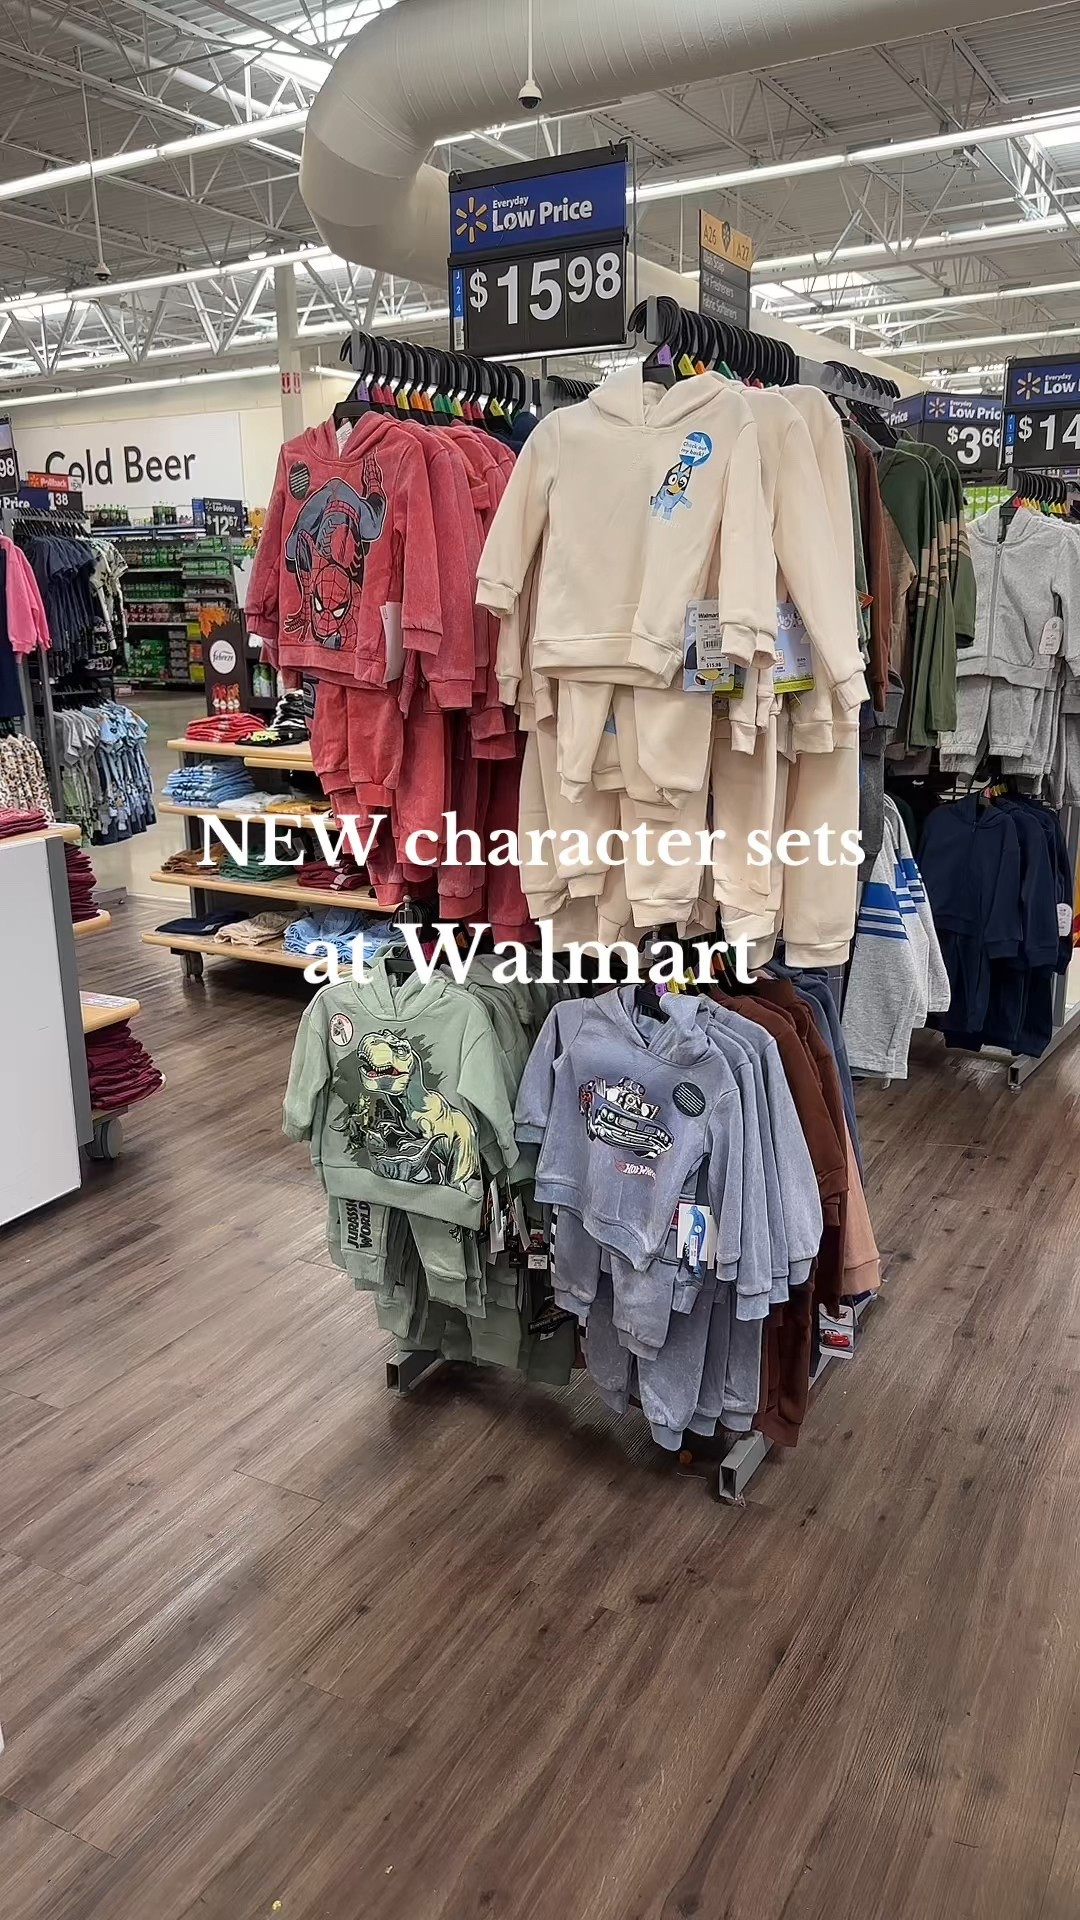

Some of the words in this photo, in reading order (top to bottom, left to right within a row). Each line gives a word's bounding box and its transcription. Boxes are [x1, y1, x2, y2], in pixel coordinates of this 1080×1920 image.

[492, 196, 529, 209] Everyday
[492, 209, 535, 232] Low
[540, 197, 593, 225] Price
[1045, 373, 1072, 381] Everyday
[1044, 381, 1077, 395] Low
[950, 400, 973, 408] Everyday
[890, 410, 909, 426] Price
[949, 406, 975, 419] Low
[976, 407, 1001, 420] Pric
[123, 445, 196, 483] Beer
[2, 497, 31, 509] Price
[359, 1200, 373, 1248] WORLD
